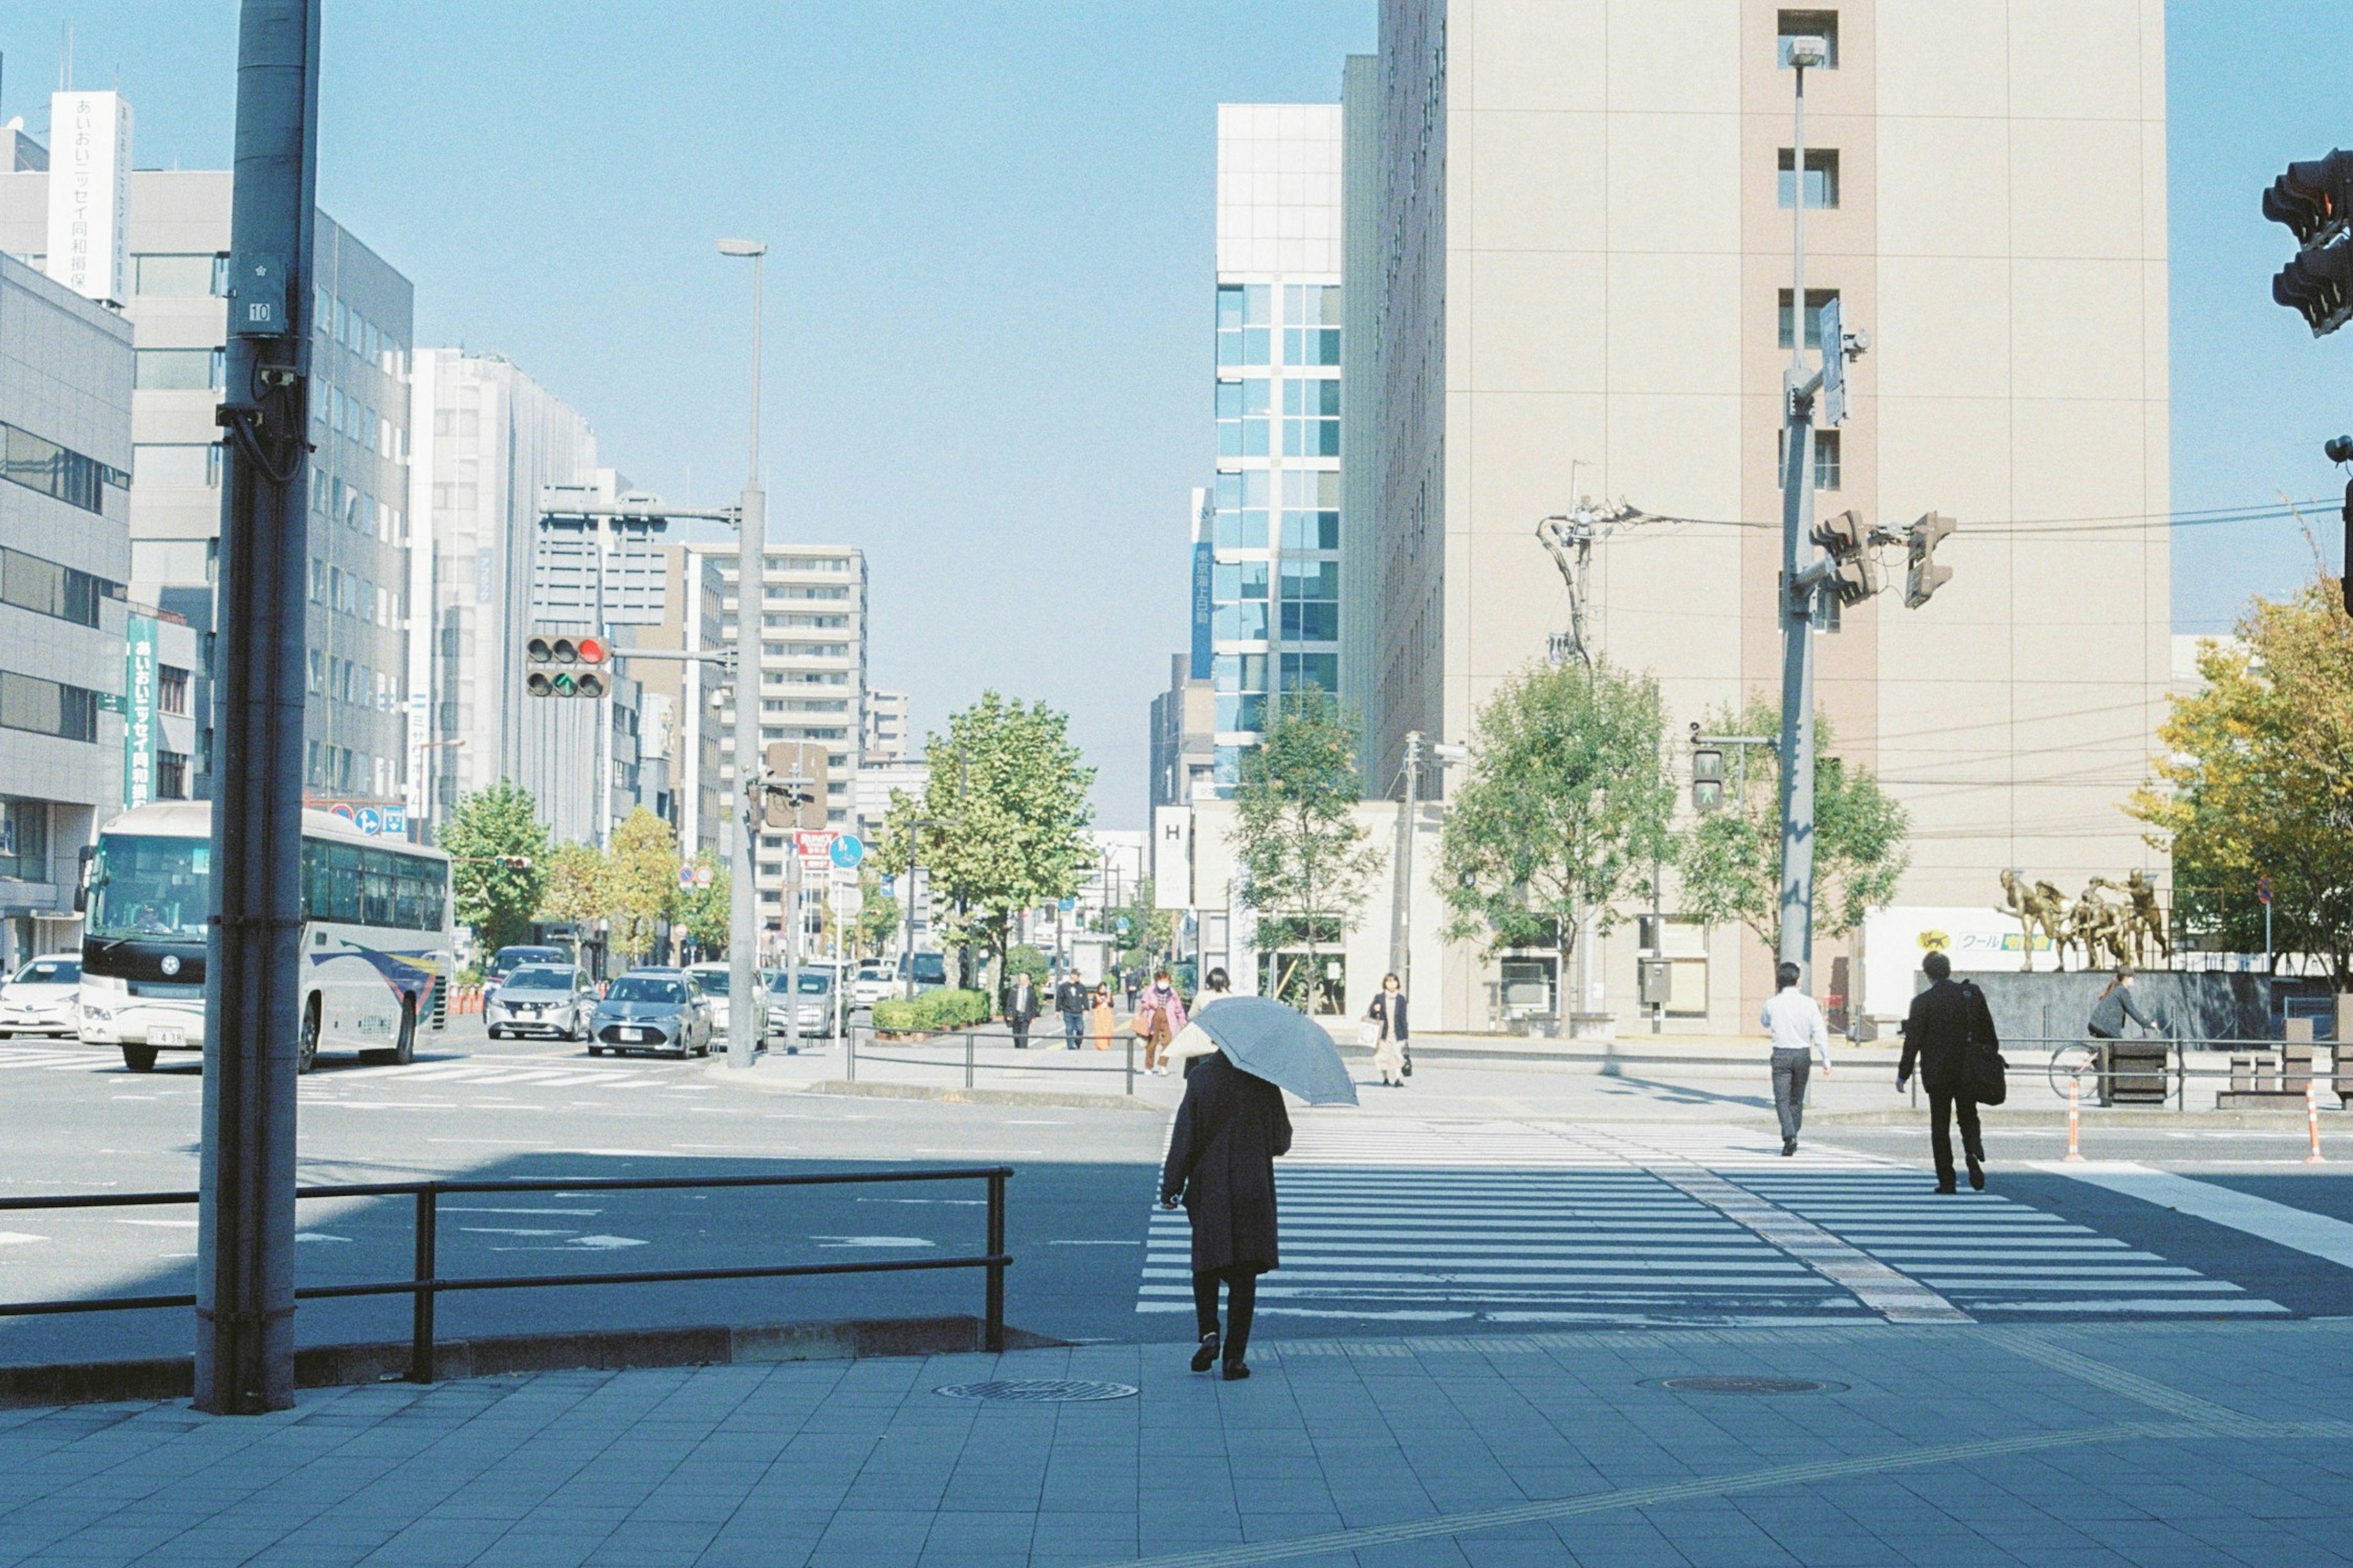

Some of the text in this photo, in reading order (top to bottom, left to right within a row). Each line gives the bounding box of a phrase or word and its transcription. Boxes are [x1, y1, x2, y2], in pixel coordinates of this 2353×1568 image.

[70, 100, 92, 289] あいおいニッセイ同和損保
[251, 304, 268, 320] 10
[1165, 824, 1180, 840] H
